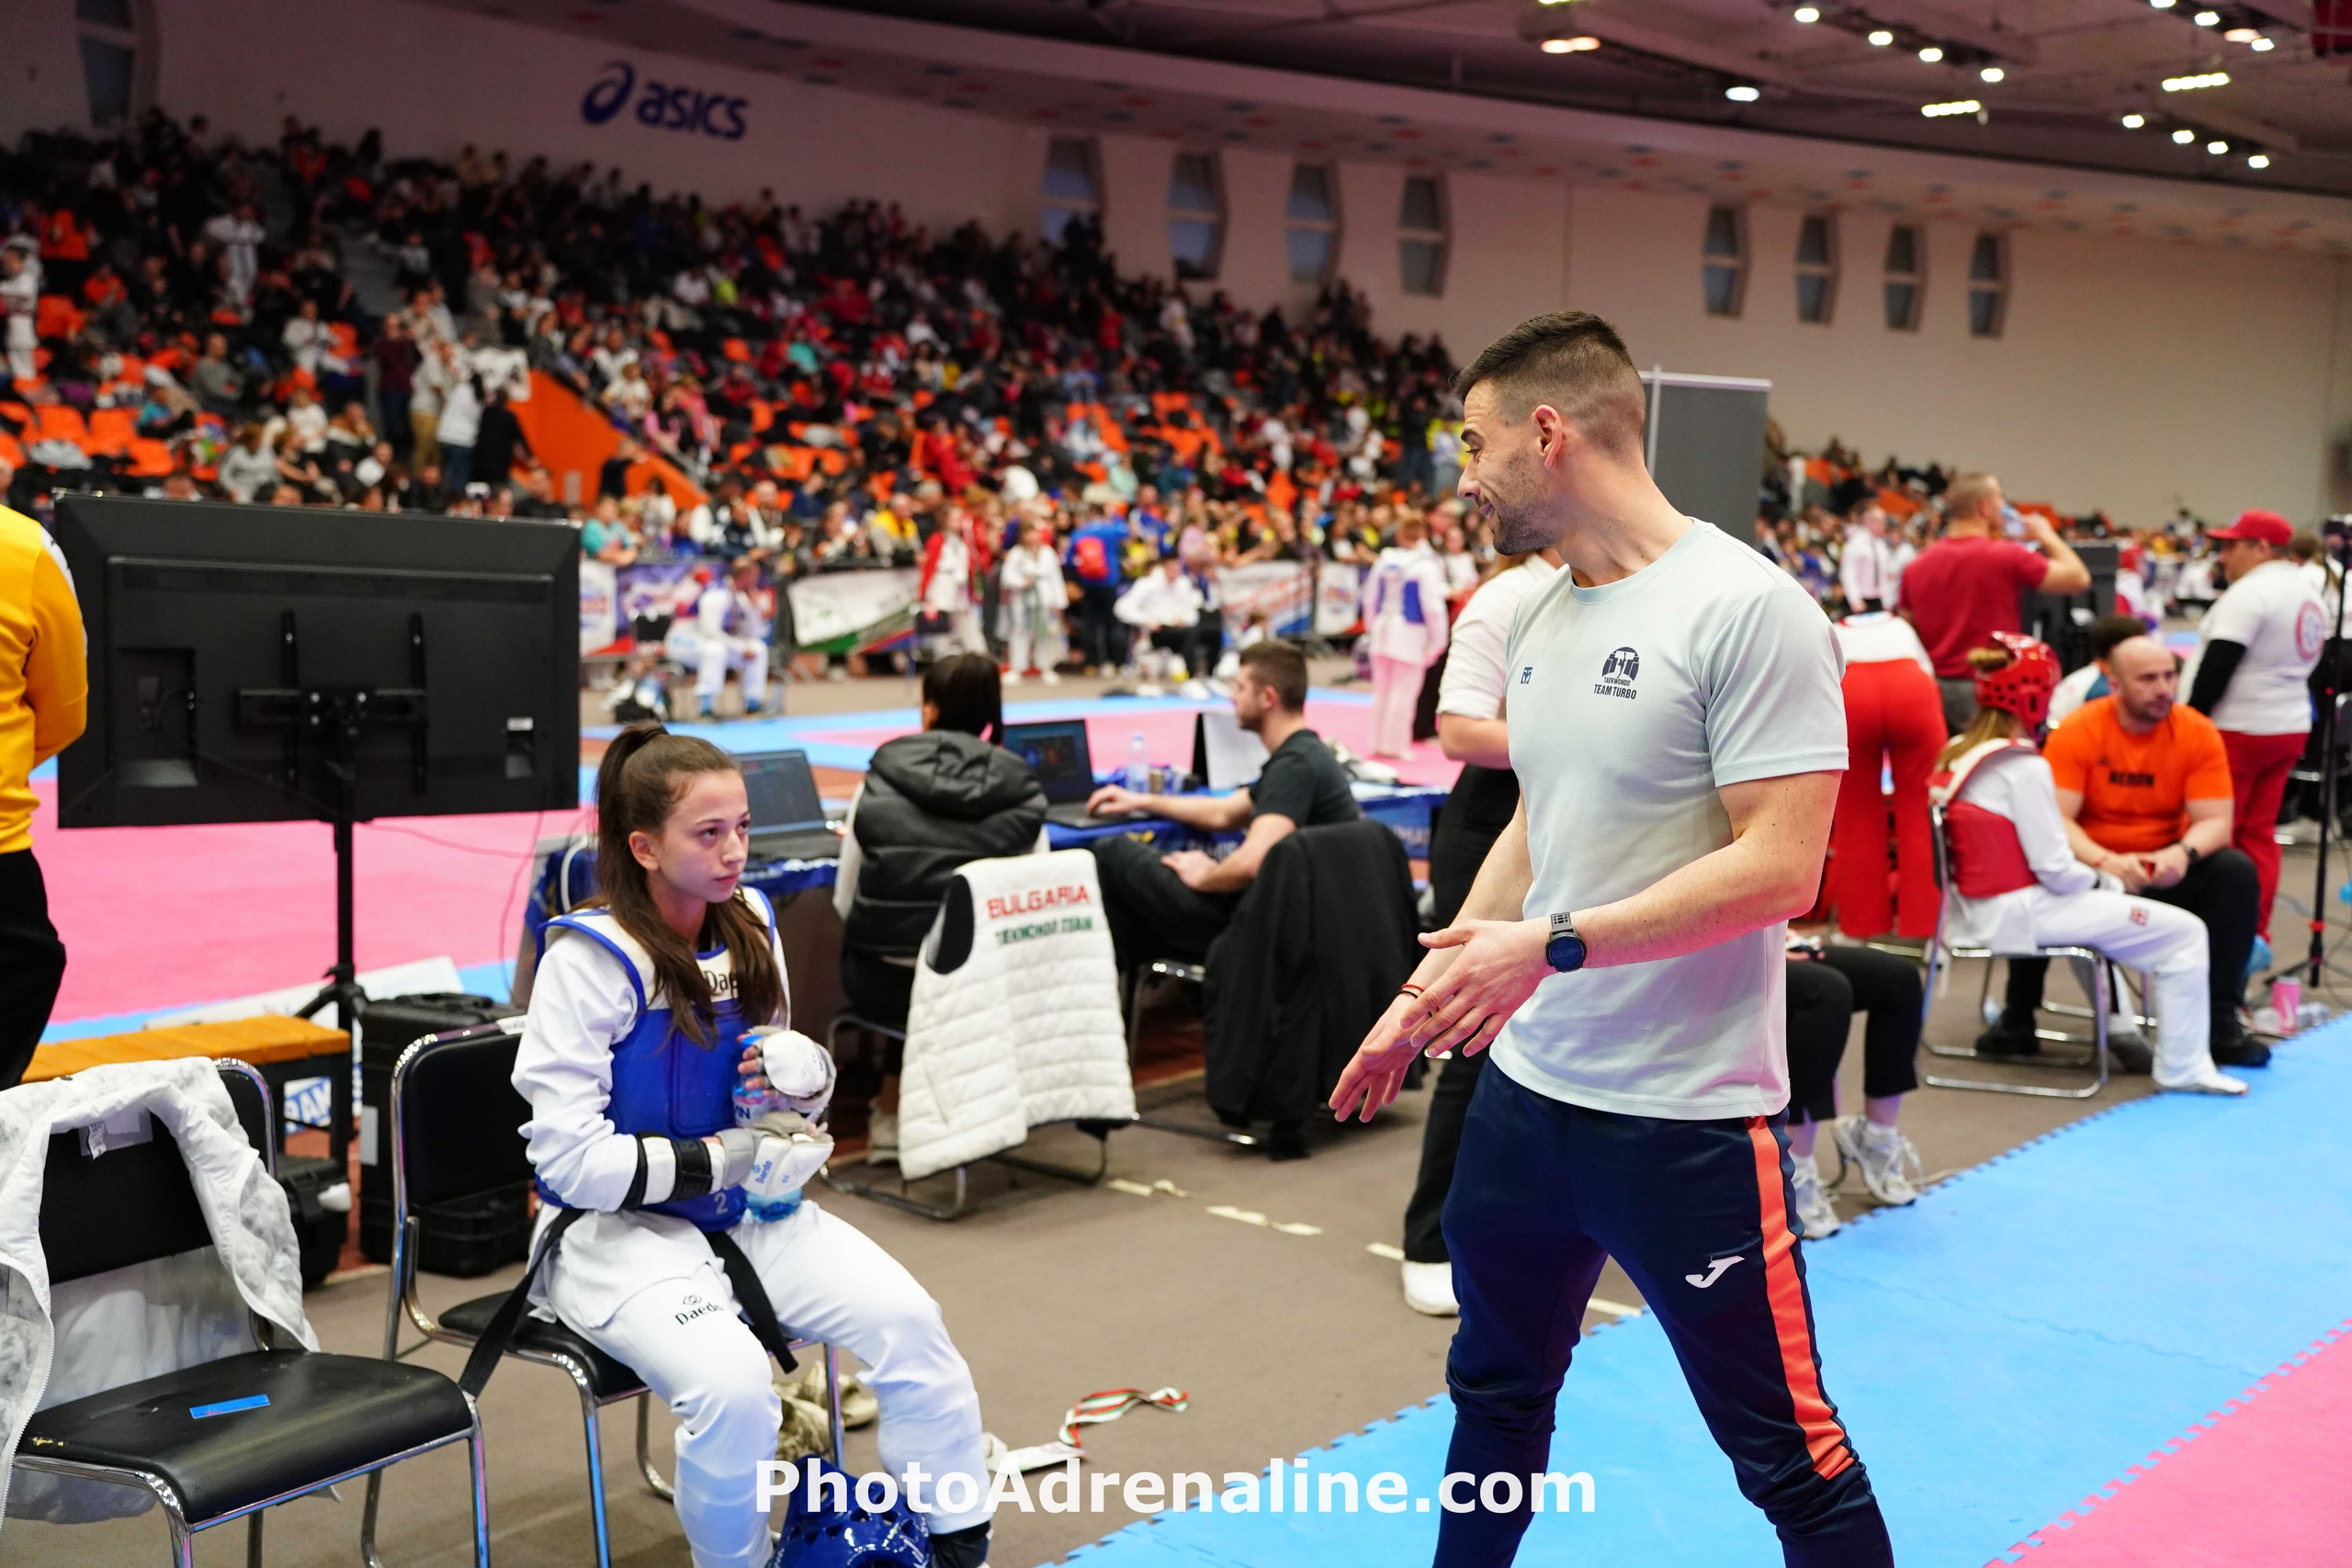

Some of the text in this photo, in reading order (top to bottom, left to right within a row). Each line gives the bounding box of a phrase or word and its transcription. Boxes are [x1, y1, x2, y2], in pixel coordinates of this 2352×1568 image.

[1593, 683, 1637, 700] TEAM TURBO
[1603, 676, 1631, 687] TAEKWONDO
[987, 885, 1091, 919] BULGARIA
[714, 1191, 729, 1216] 2
